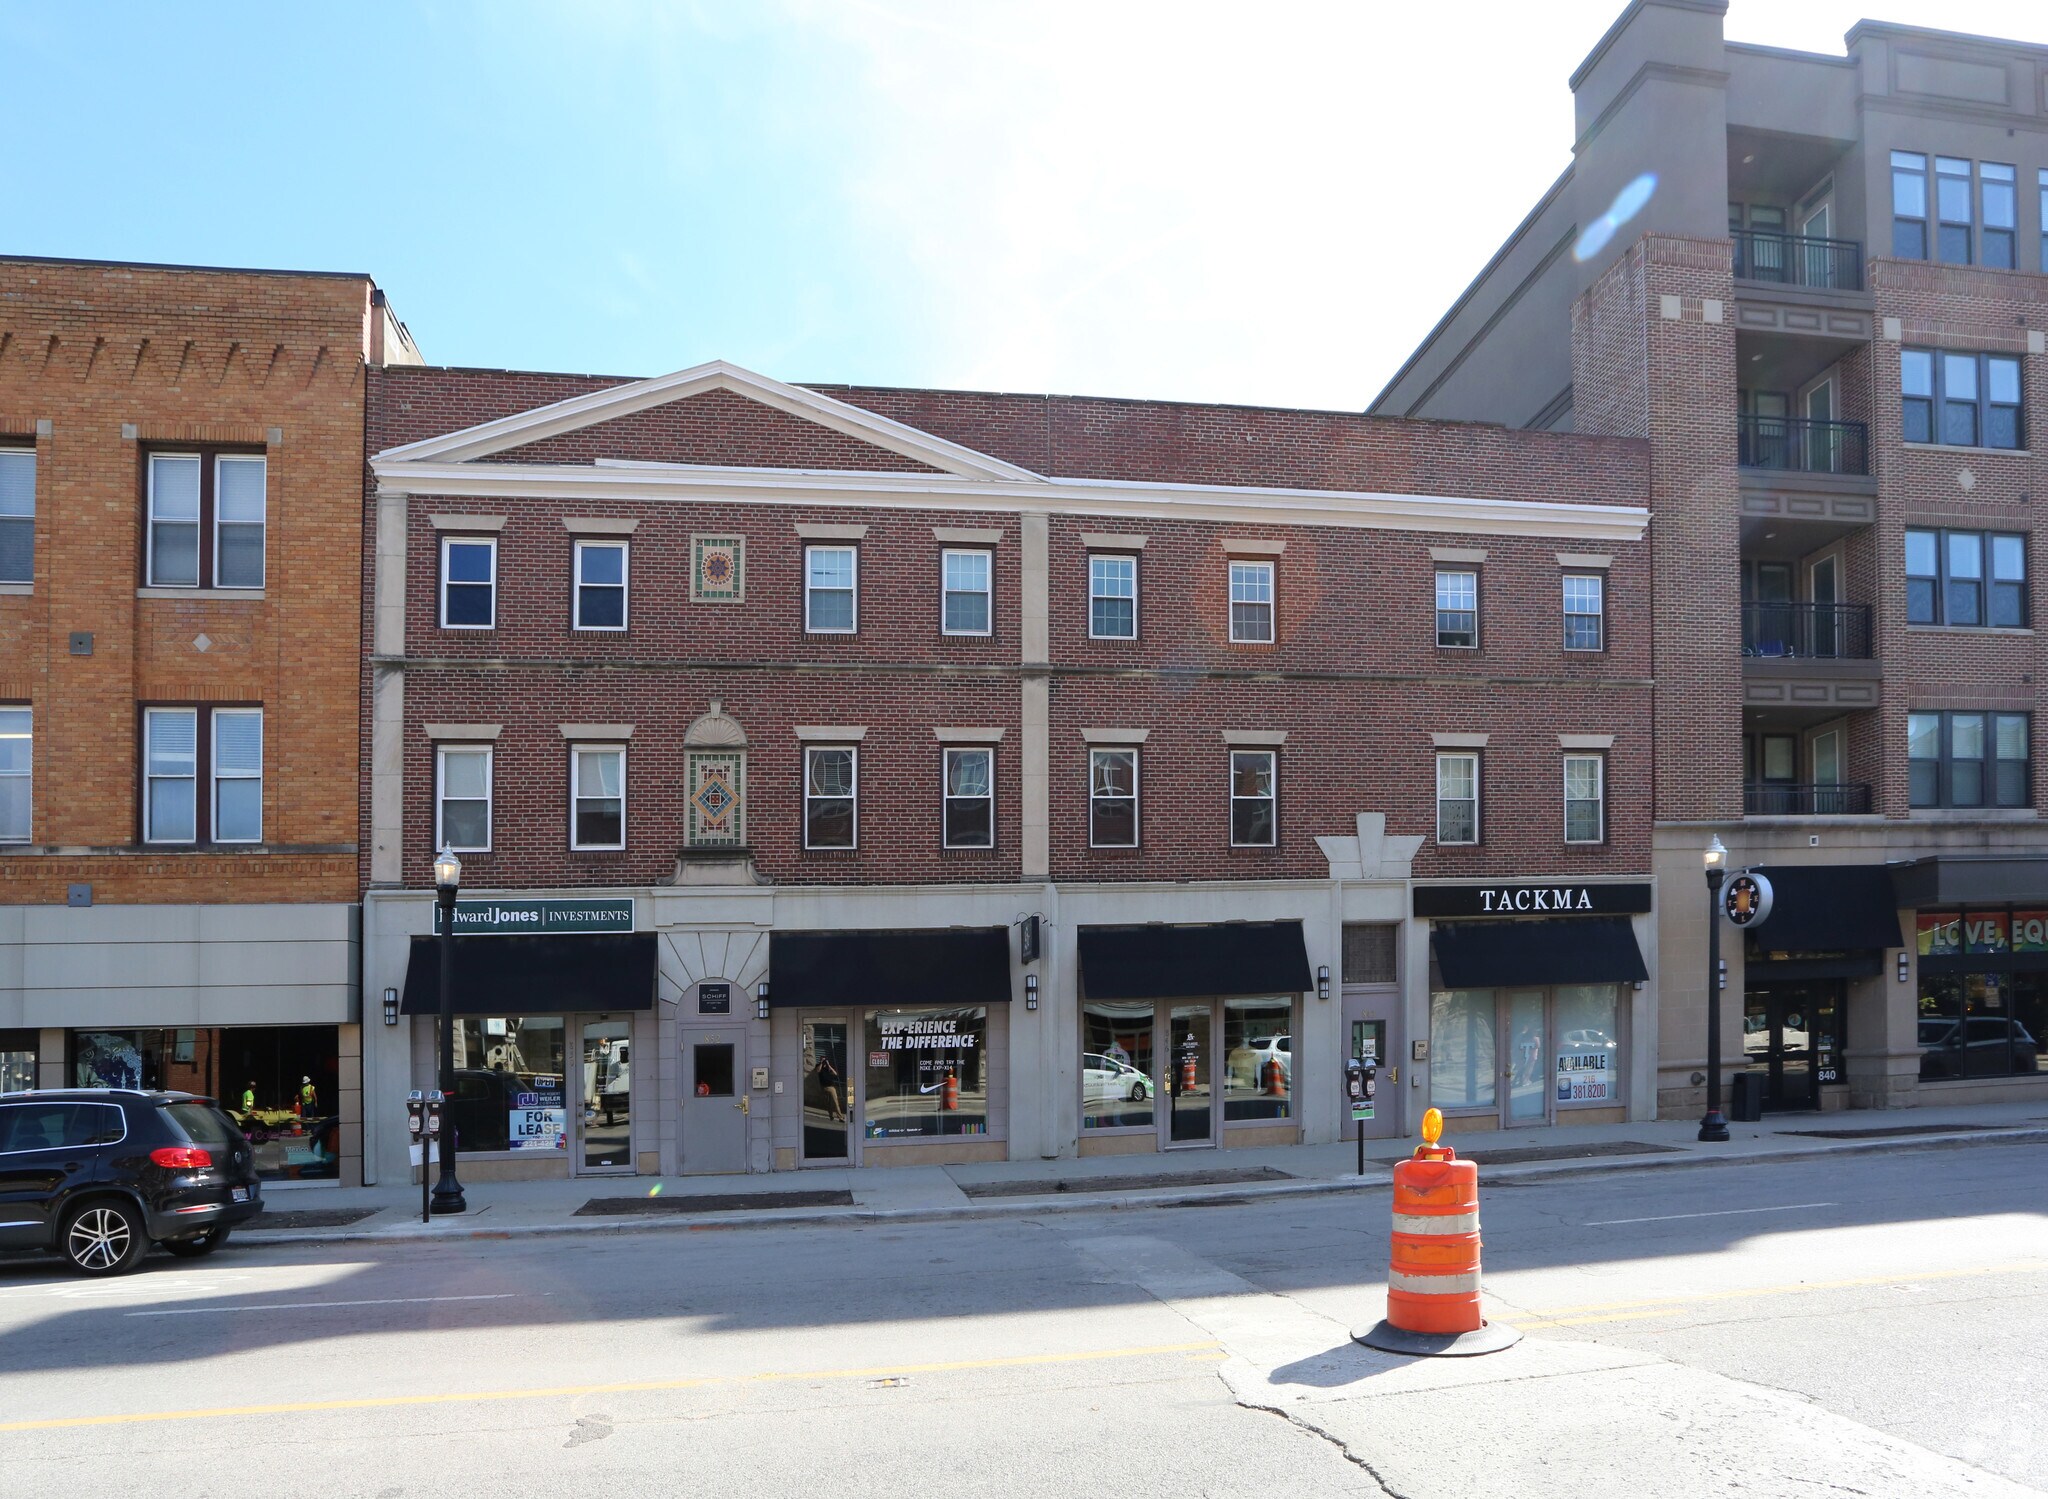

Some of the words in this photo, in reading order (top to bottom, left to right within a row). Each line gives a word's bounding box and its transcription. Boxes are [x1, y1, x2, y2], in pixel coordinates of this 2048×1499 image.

[1480, 889, 1593, 911] TACKMA
[549, 910, 630, 922] INVESTMENTS
[1934, 920, 2005, 949] LOVE,
[2012, 919, 2048, 945] EQ
[881, 1020, 957, 1035] EXP-ERIENCE
[881, 1036, 903, 1050] THE
[905, 1034, 975, 1049] DIFFERENCE
[1558, 1055, 1606, 1072] AVAILABLE
[1818, 1070, 1836, 1081] 840
[1572, 1083, 1606, 1099] 381.8200
[526, 1111, 553, 1122] FOR
[518, 1123, 561, 1135] LEASE
